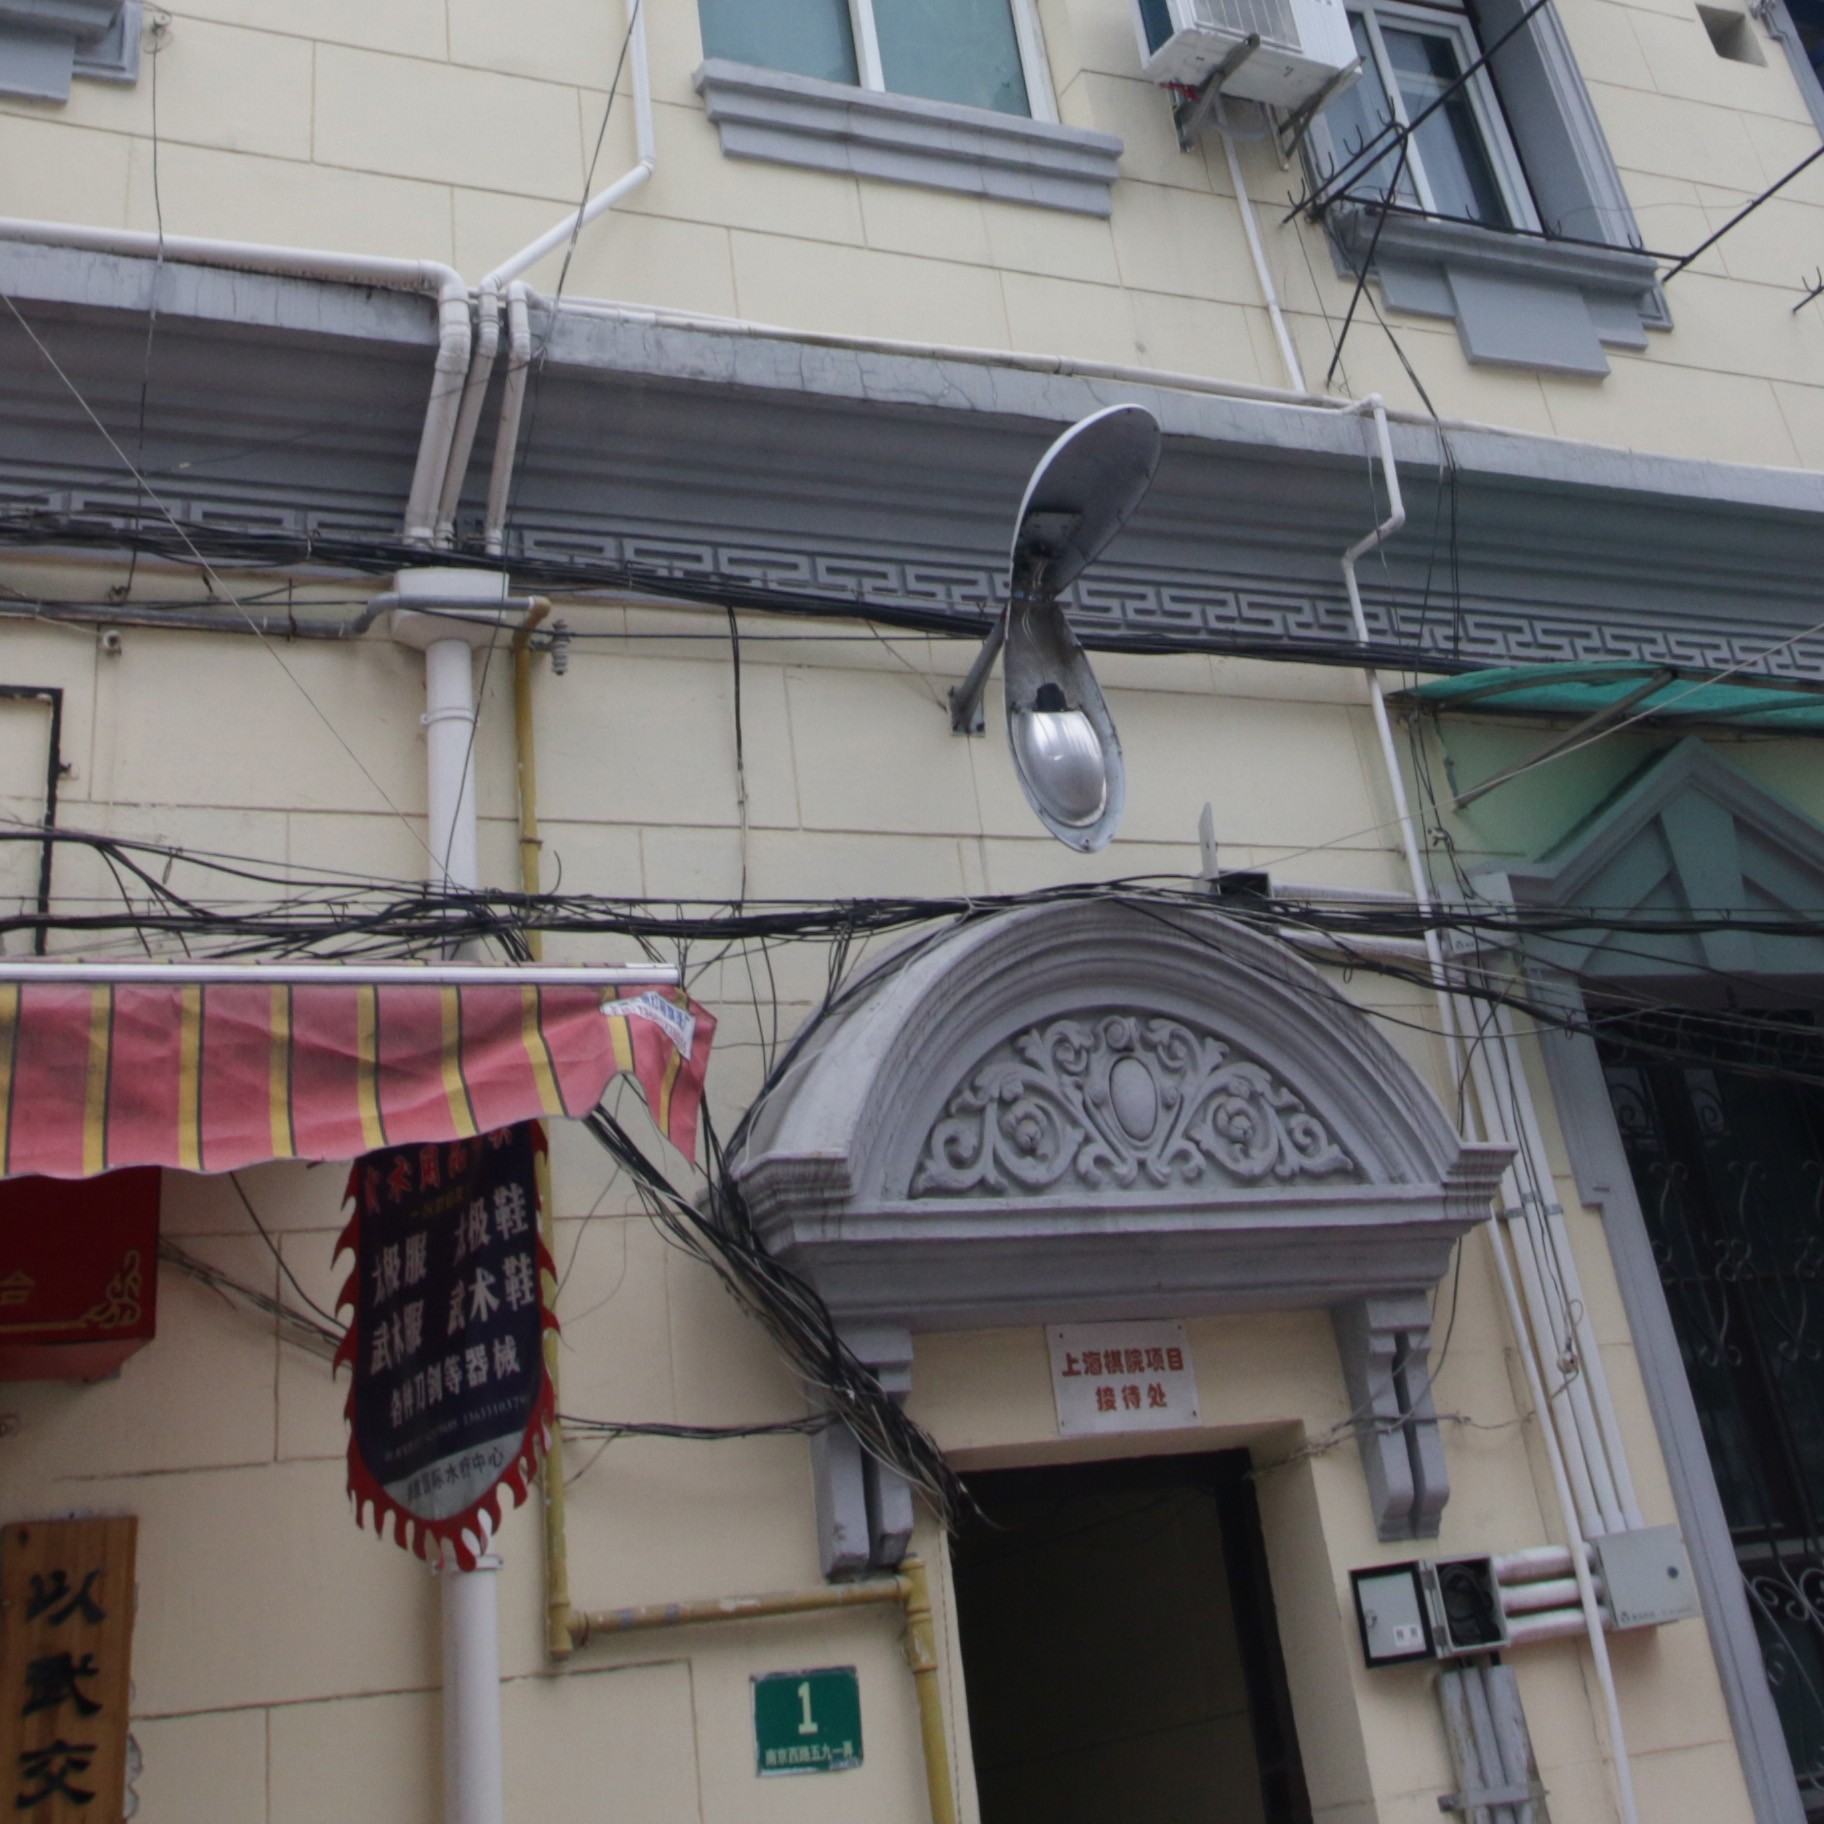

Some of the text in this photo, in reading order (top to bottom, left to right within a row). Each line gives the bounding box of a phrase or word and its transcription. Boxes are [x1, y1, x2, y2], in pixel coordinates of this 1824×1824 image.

[453, 1183, 528, 1266] 太极鞋
[447, 1252, 535, 1336] 武术鞋
[1061, 1346, 1184, 1377] 上海棋院项目
[1095, 1382, 1168, 1412] 接待处
[798, 1681, 818, 1735] 1
